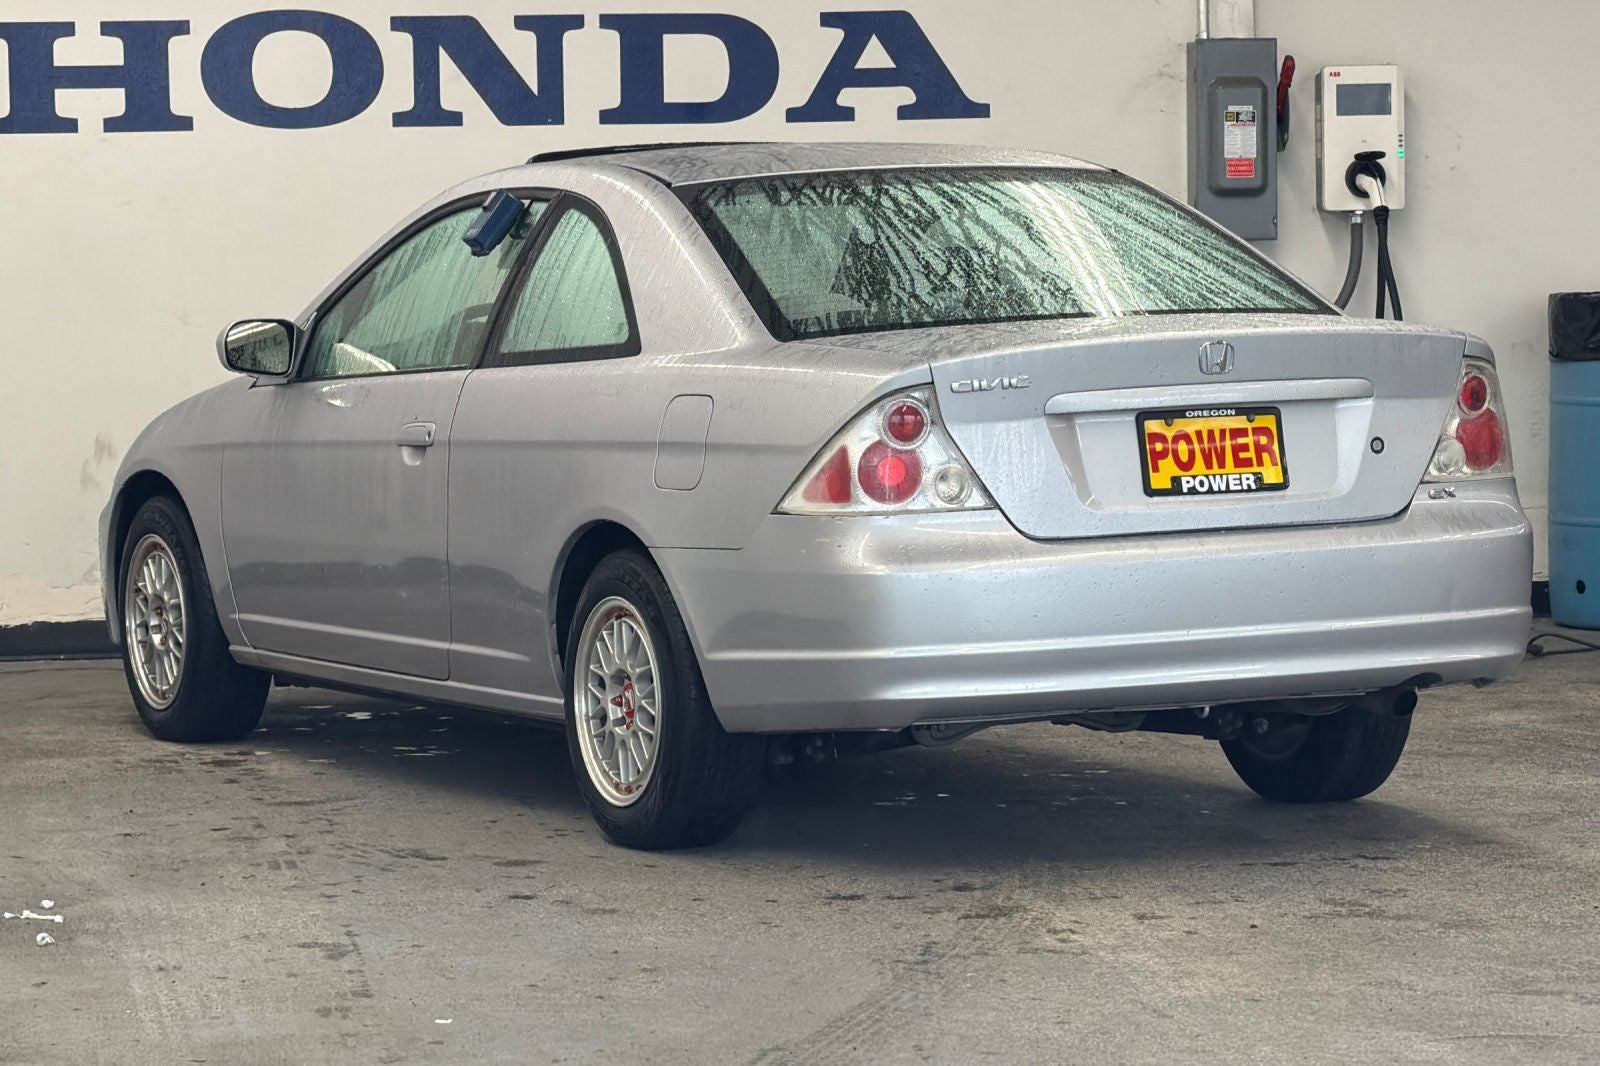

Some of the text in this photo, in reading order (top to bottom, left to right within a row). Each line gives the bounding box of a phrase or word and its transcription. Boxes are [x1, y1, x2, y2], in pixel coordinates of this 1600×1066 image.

[0, 9, 990, 134] HONDA
[950, 375, 1031, 393] CIVIC
[1185, 409, 1236, 418] OREGON
[1146, 426, 1279, 473] POWER
[1181, 473, 1257, 493] POWER
